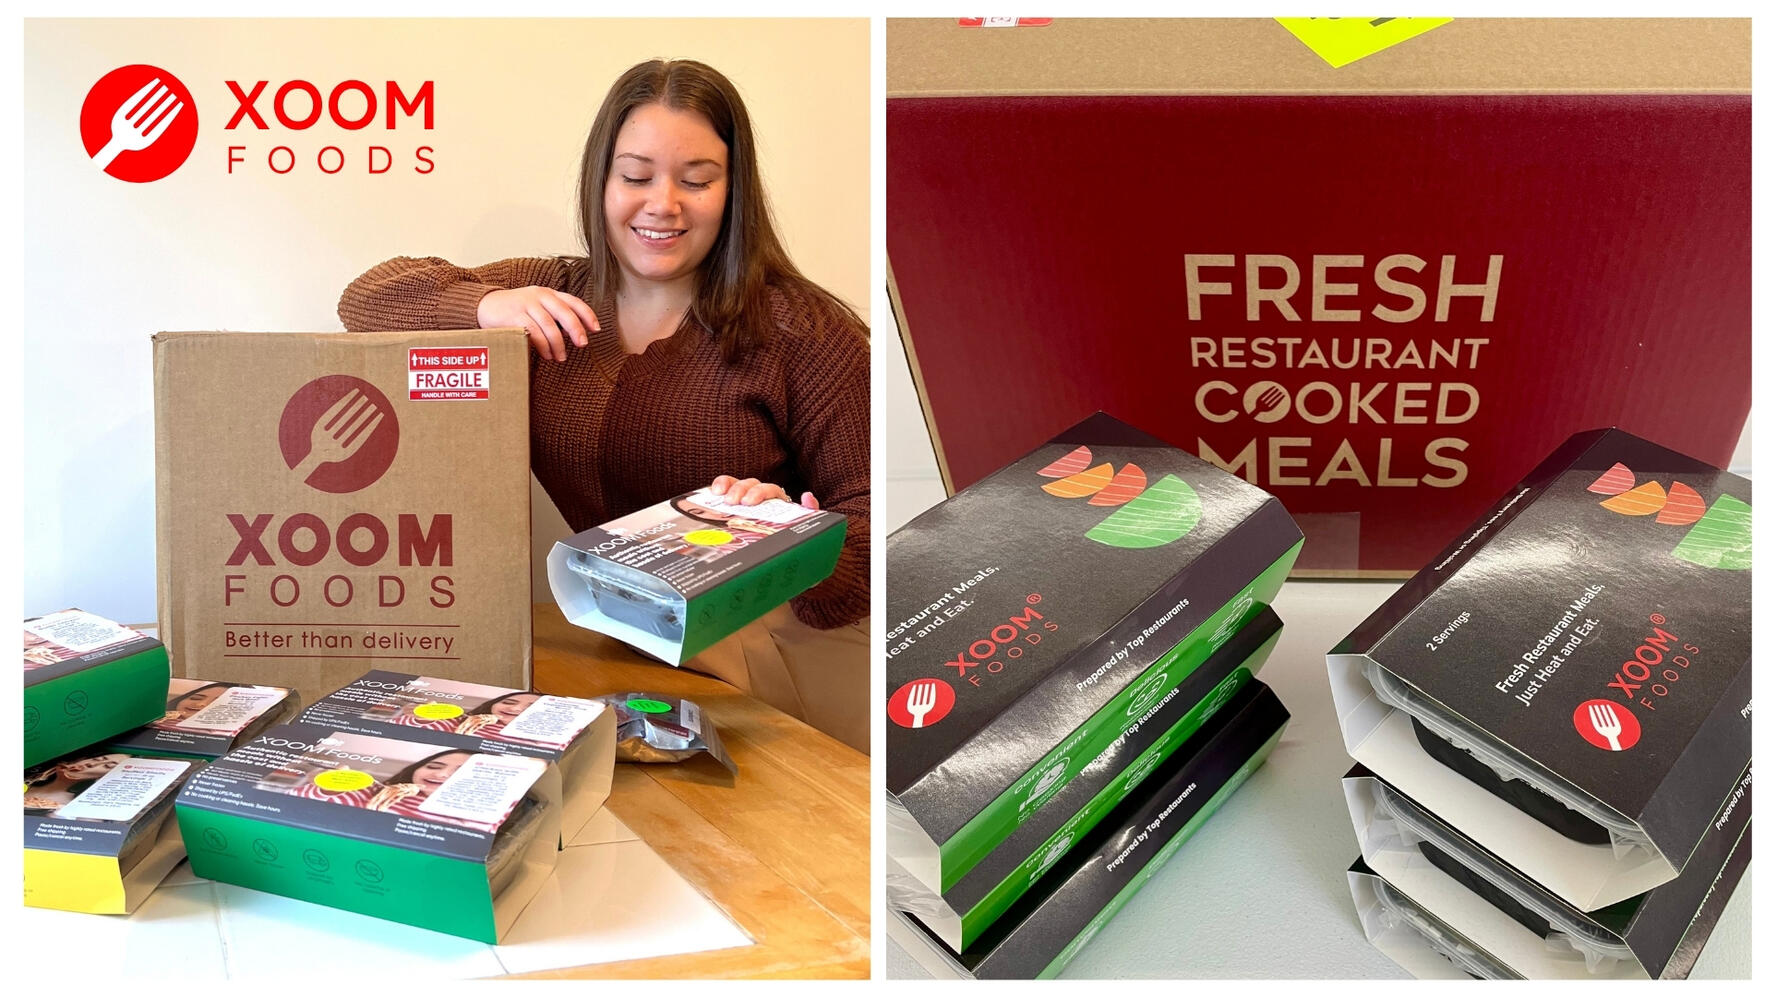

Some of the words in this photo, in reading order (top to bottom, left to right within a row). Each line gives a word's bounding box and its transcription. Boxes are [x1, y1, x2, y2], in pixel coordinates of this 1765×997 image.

[1184, 254, 1504, 323] FRESH
[419, 356, 439, 366] THIS
[442, 356, 463, 366] SIDE
[465, 356, 480, 366] UP
[1191, 337, 1490, 369] RESTAURANT
[416, 373, 482, 387] FRAGILE
[1195, 380, 1480, 424] COOKED
[1197, 437, 1470, 488] MEALS
[225, 513, 453, 566] XOOM
[225, 575, 455, 608] FOODS
[886, 592, 955, 643] estaurant
[952, 566, 1000, 595] Meals,
[226, 631, 293, 648] Better
[302, 632, 353, 649] than
[363, 632, 454, 653] delivery
[917, 616, 946, 639] and
[943, 598, 975, 619] Eat.
[1425, 642, 1436, 652] 2
[1432, 610, 1471, 645] Servings
[1495, 663, 1530, 694] Fresh
[1522, 607, 1578, 665] Restaurant
[1569, 583, 1606, 612] Meals,
[968, 621, 1059, 687] FOODS
[1076, 656, 1118, 692] Prepared
[1116, 647, 1130, 662] by
[1127, 633, 1145, 650] Top
[1143, 598, 1190, 638] Restaurants
[1514, 679, 1538, 707] Just
[1534, 655, 1566, 682] Heat
[1560, 632, 1582, 657] and
[1575, 616, 1600, 637] Eat.
[353, 679, 413, 694] XOOM
[414, 689, 465, 701] Foods
[1640, 643, 1700, 711] FOODS
[1113, 733, 1127, 747] by
[1124, 722, 1140, 738] Top
[1138, 687, 1180, 726] Restaurants
[254, 736, 325, 755] XOOM
[323, 749, 383, 765] Foods
[1106, 837, 1140, 872] Prepared
[1137, 830, 1149, 842] by
[1145, 818, 1161, 833] Top
[1158, 782, 1197, 821] Restaurants
[1715, 796, 1739, 831] Prepared
[1735, 787, 1745, 799] by
[1741, 773, 1752, 789] Top
